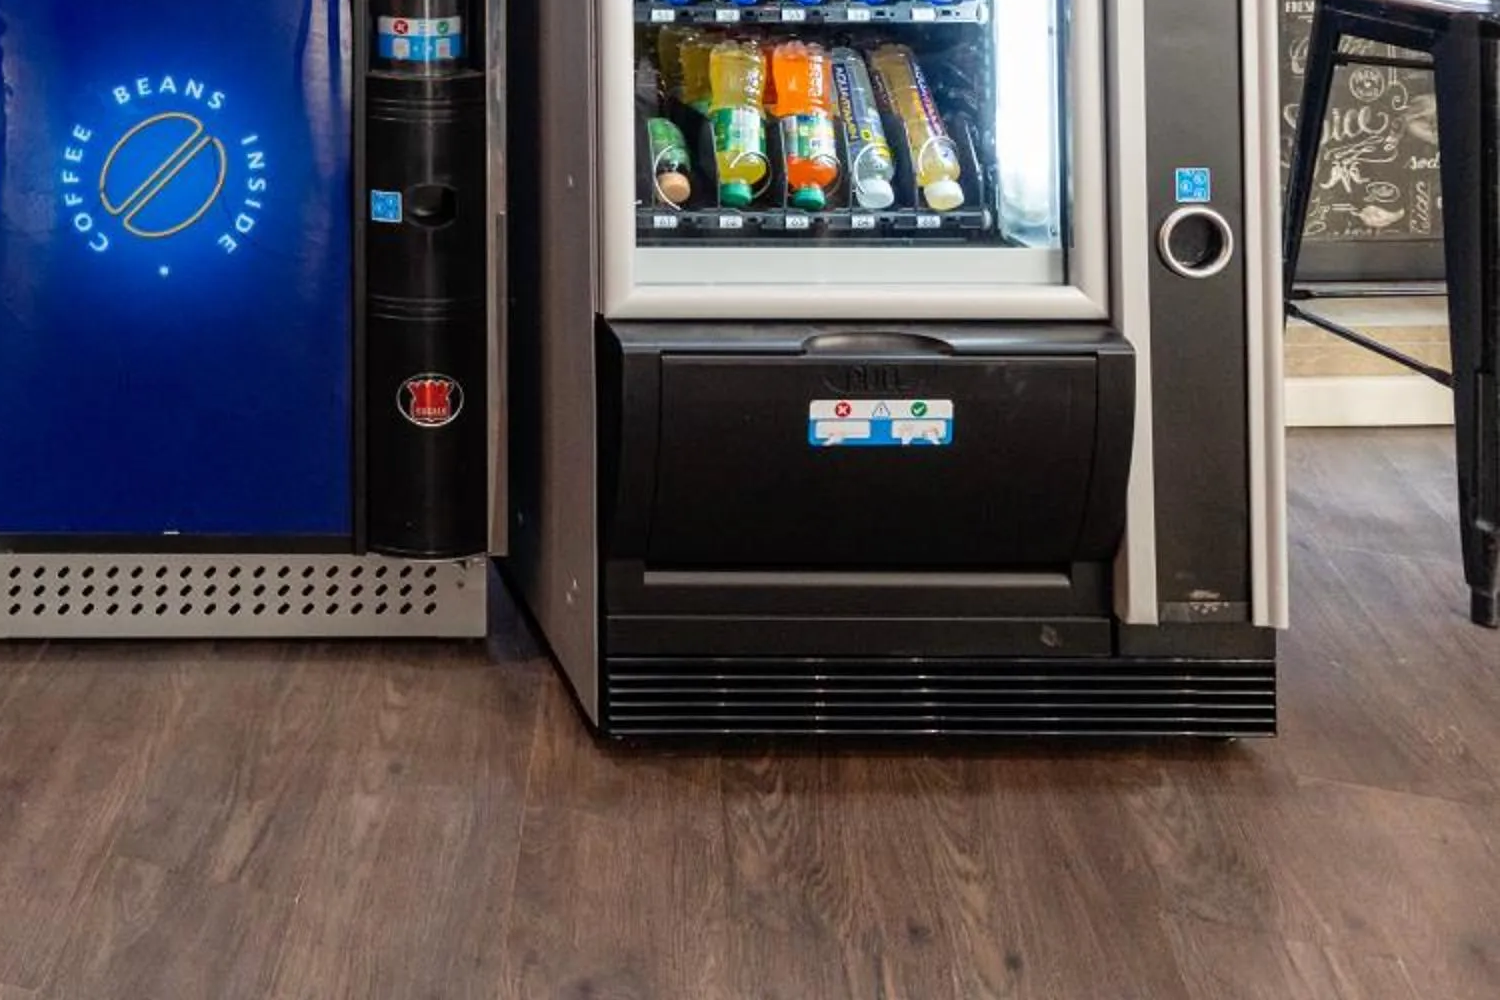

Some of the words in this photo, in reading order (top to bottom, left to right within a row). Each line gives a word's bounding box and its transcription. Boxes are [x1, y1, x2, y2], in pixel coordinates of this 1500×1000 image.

[112, 75, 225, 109] BEANS
[62, 124, 109, 253] COFFEE
[216, 133, 267, 254] INSIDE
